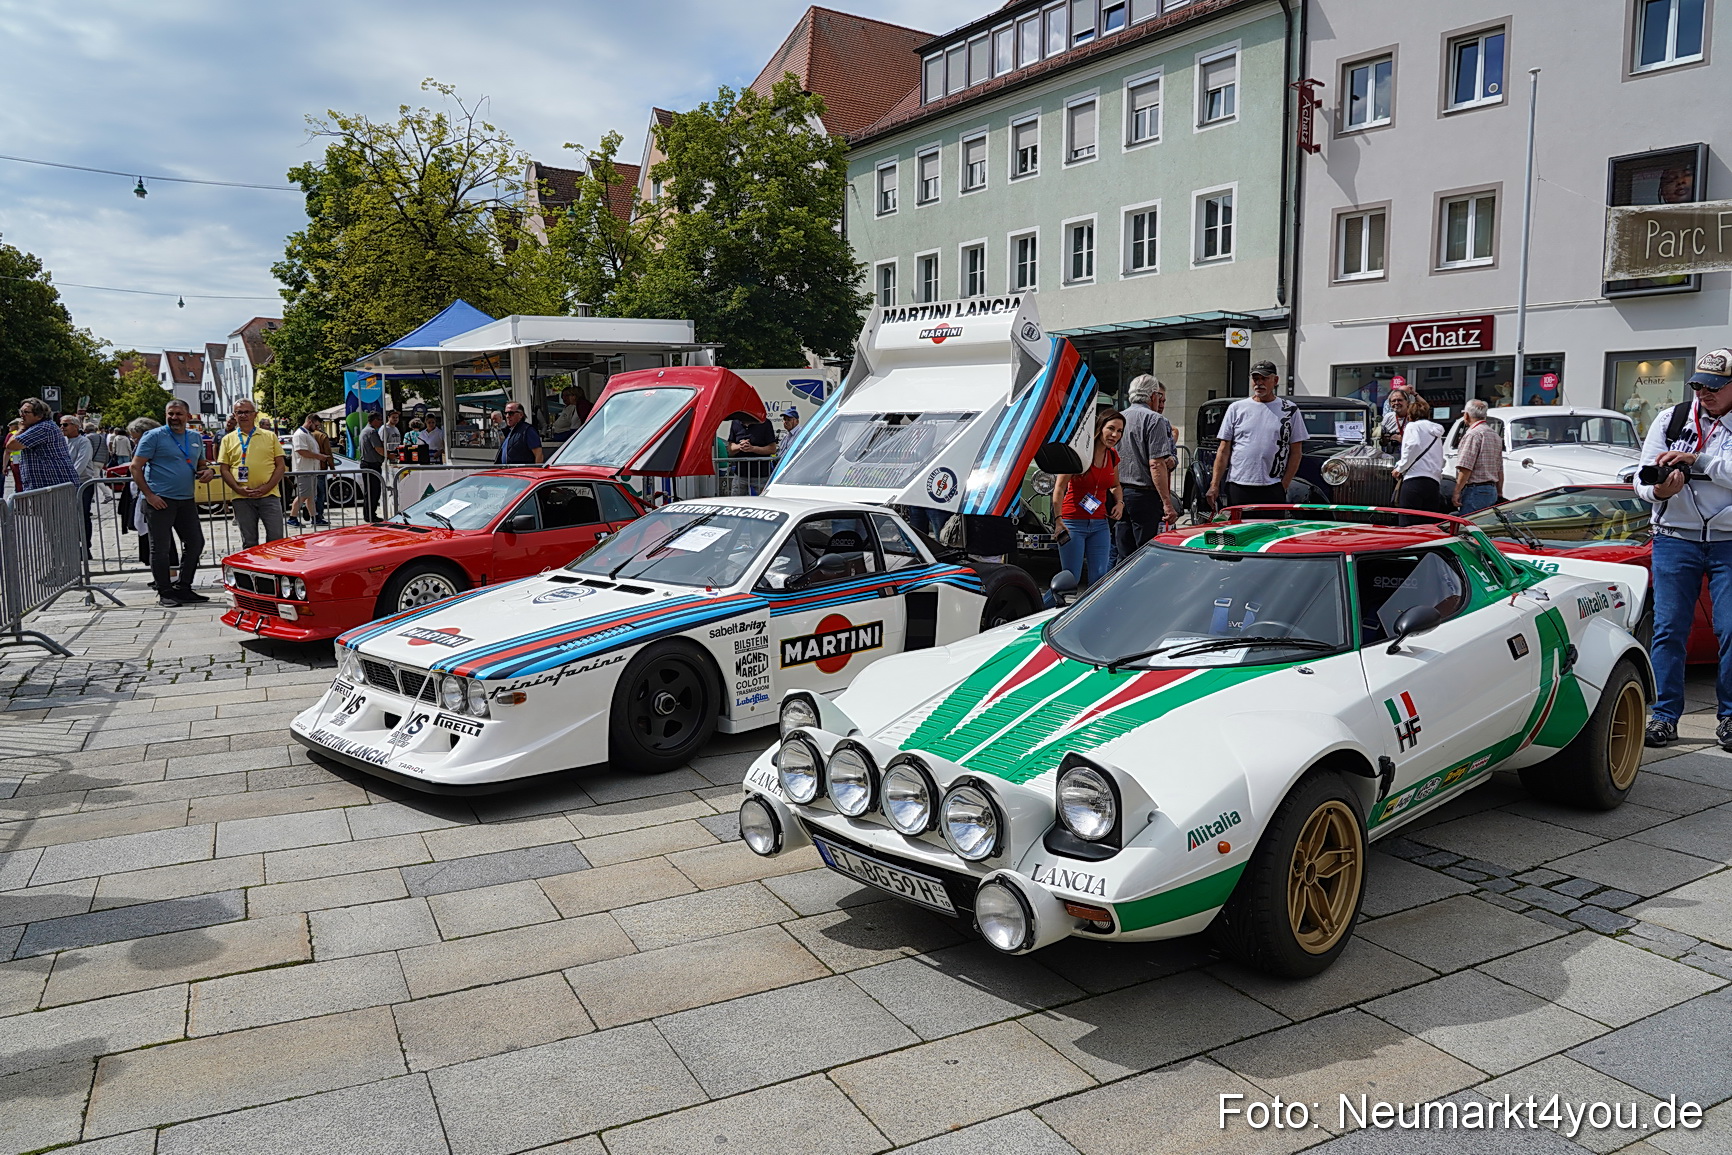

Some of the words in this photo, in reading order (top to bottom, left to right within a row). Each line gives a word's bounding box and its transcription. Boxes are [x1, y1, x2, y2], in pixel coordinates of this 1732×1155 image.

[1302, 95, 1312, 143] Achatz
[1645, 219, 1706, 259] Parc
[882, 303, 952, 324] MARTINI
[954, 296, 1021, 318] LANCIA
[921, 328, 962, 338] MARTINI
[1396, 324, 1481, 353] Achatz
[1635, 376, 1665, 386] Achatz
[661, 504, 719, 515] MARTINI
[718, 507, 780, 521] RACING
[831, 538, 855, 546] sparco
[1373, 576, 1418, 588] sparco
[1577, 591, 1609, 619] Alitalia
[402, 629, 469, 646] MARTINI
[709, 623, 739, 639] sabelt
[739, 620, 767, 635] Britax
[734, 635, 769, 650] BILSTEIN
[784, 625, 880, 664] MARTINI
[488, 655, 627, 700] pininfarina
[736, 675, 769, 690] COLOTTI
[736, 684, 769, 696] TRASMISSIONI
[342, 694, 366, 714] VS
[736, 693, 770, 707] Lubrifilm
[433, 712, 484, 737] PIRELLI
[1394, 715, 1421, 754] HF
[310, 729, 352, 752] MARTINI
[346, 743, 389, 765] LANCIA
[749, 768, 783, 797] LANCIA
[1187, 810, 1242, 852] Alitalia
[1031, 863, 1106, 897] LANCIA
